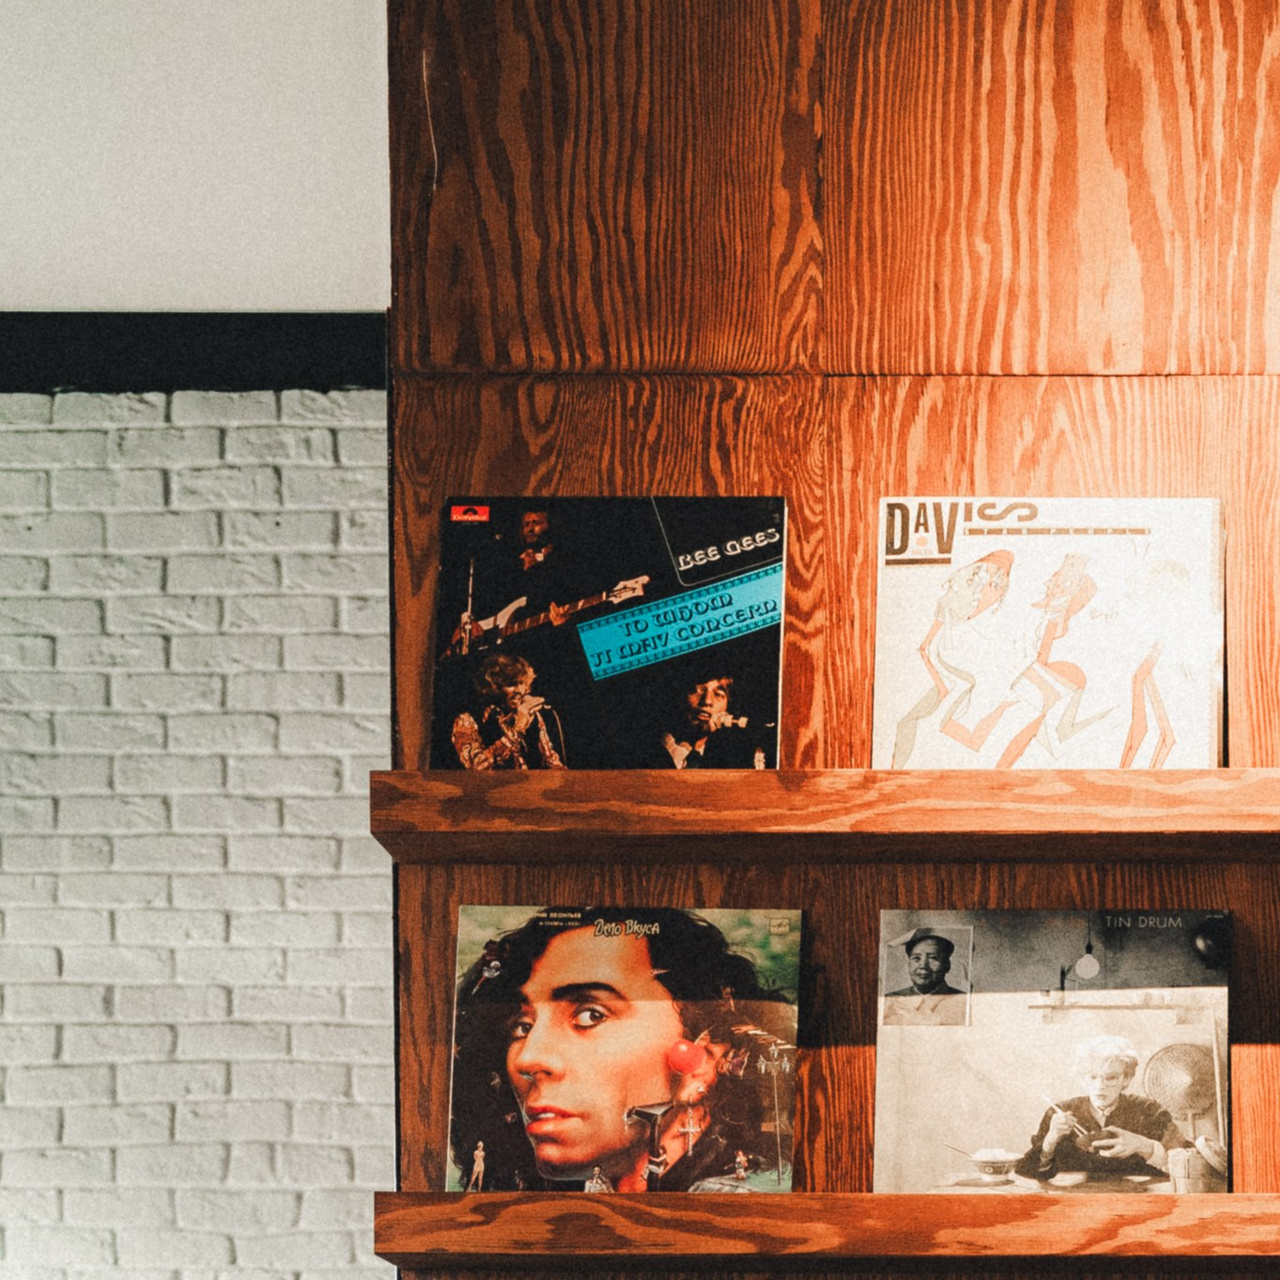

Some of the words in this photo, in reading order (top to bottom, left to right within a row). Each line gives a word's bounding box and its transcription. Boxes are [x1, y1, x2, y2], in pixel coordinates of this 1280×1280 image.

[677, 546, 721, 571] BEE
[723, 528, 780, 556] GEES
[885, 501, 1039, 555] DAVIS
[619, 618, 649, 637] TO
[652, 592, 733, 627] WHOM
[676, 599, 778, 642] CONCERN
[1105, 915, 1131, 928] TIN
[1138, 916, 1183, 928] DRUM
